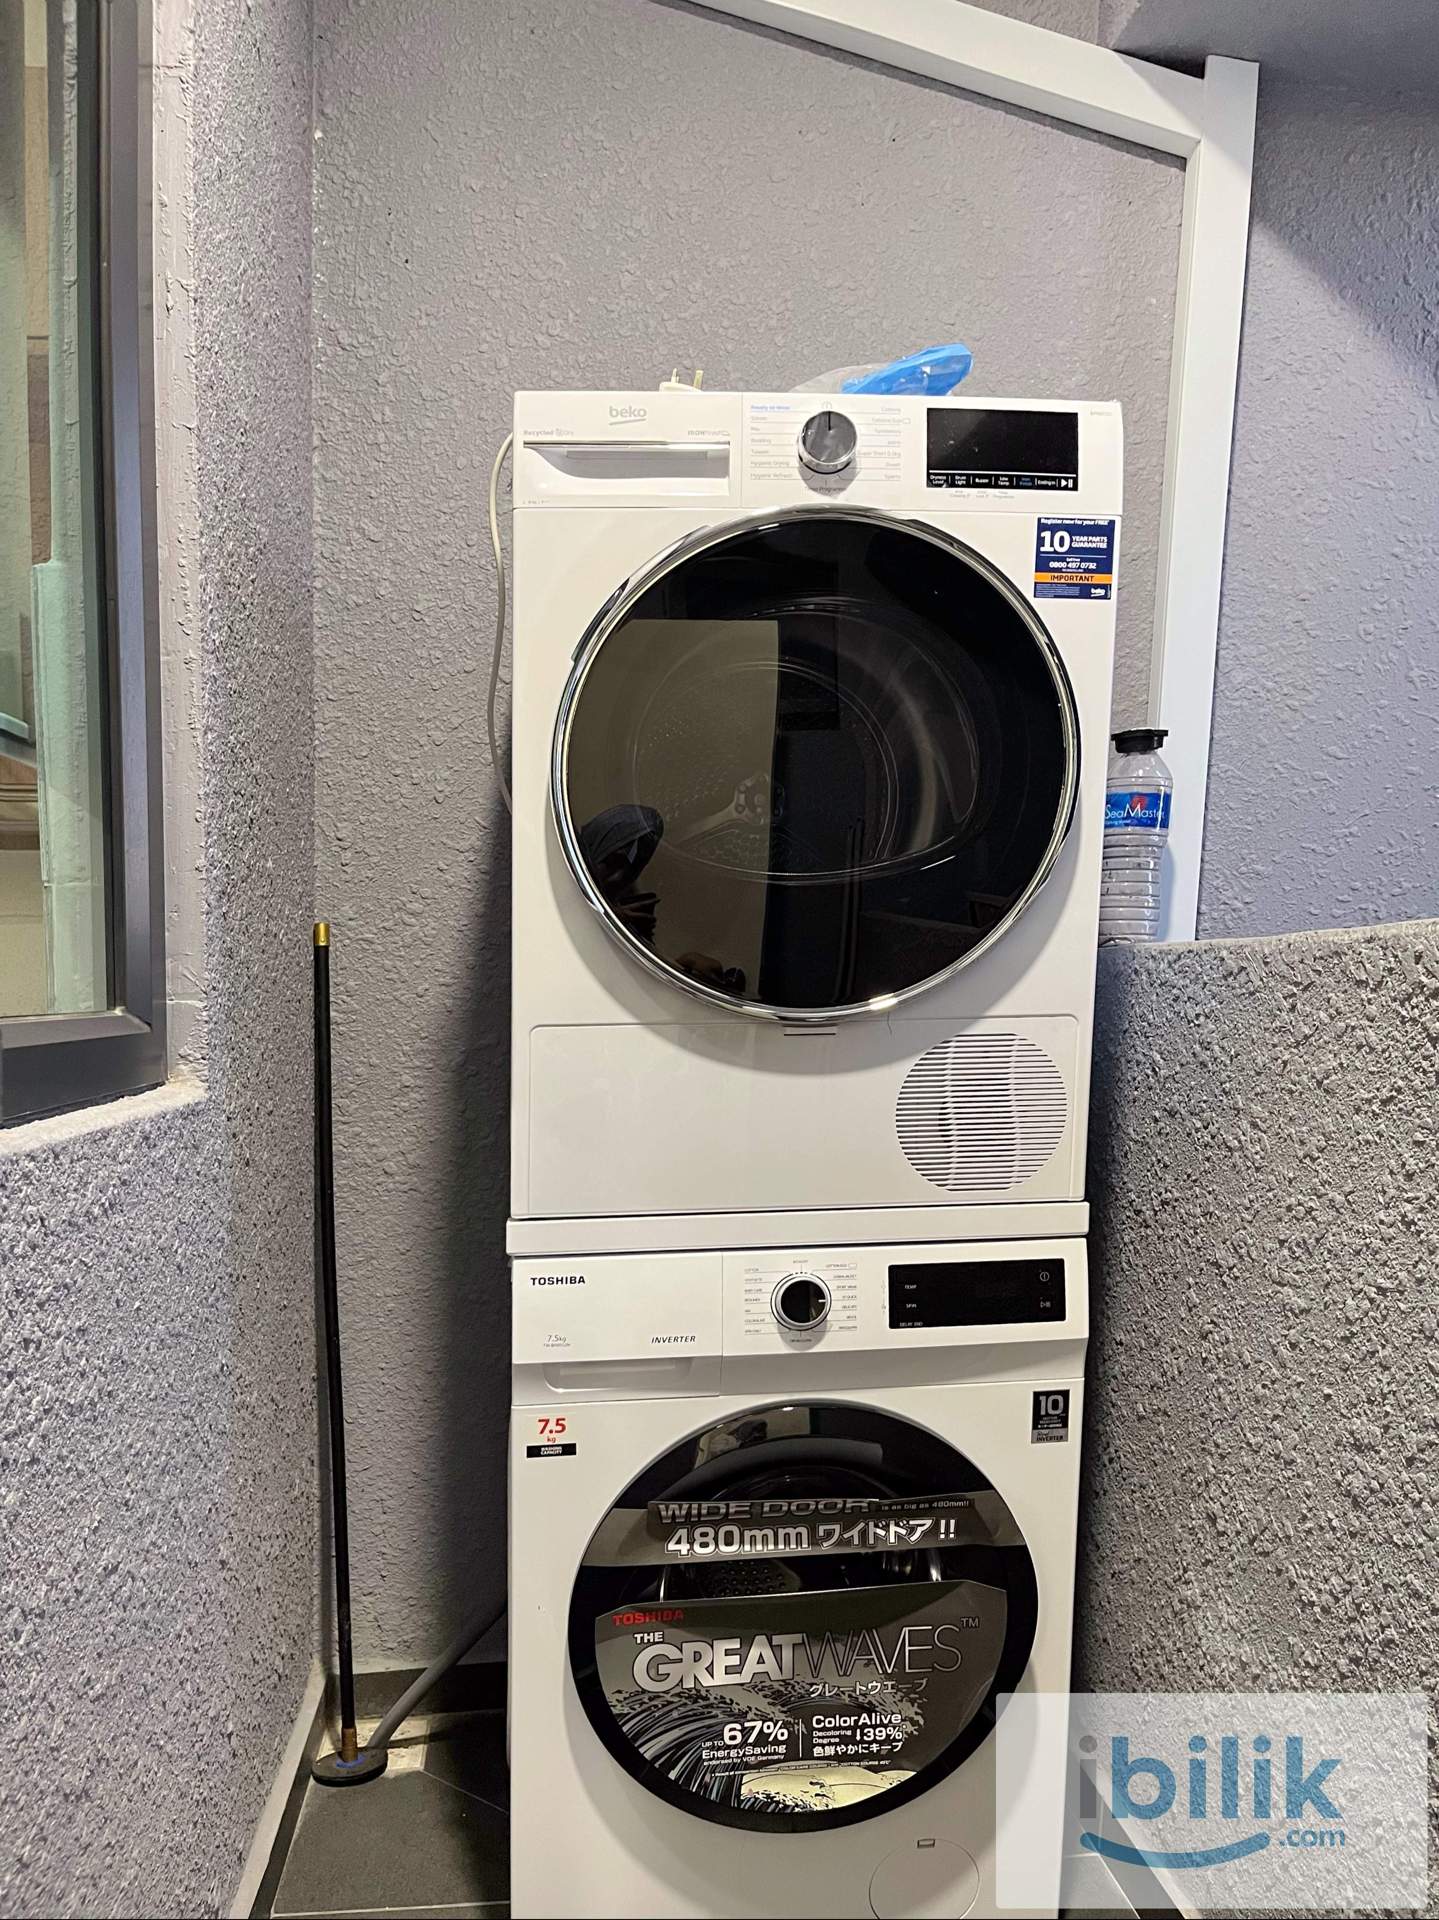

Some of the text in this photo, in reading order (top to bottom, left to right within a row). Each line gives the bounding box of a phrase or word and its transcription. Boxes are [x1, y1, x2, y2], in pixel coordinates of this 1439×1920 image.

[608, 406, 647, 418] beko
[1041, 518, 1063, 526] Register
[1040, 530, 1070, 553] 10
[1050, 575, 1096, 583] IMPORTANT
[530, 1276, 586, 1286] TOSHIBA
[651, 1335, 696, 1344] INVERTER
[1039, 1394, 1064, 1416] 10
[538, 1417, 567, 1434] 7.5
[658, 1503, 752, 1523] WIDE
[761, 1499, 870, 1517] DOOR
[666, 1524, 810, 1557] 480mm
[817, 1517, 934, 1550] ワイドドア
[612, 1609, 684, 1626] TOSHIBA
[634, 1632, 664, 1643] THE
[812, 1712, 902, 1729] ColorAlive
[723, 1720, 789, 1746] 67%
[813, 1730, 852, 1738] Decoloring
[702, 1744, 787, 1760] EnergySaving
[813, 1741, 904, 1757] 色鮮やかにキープ
